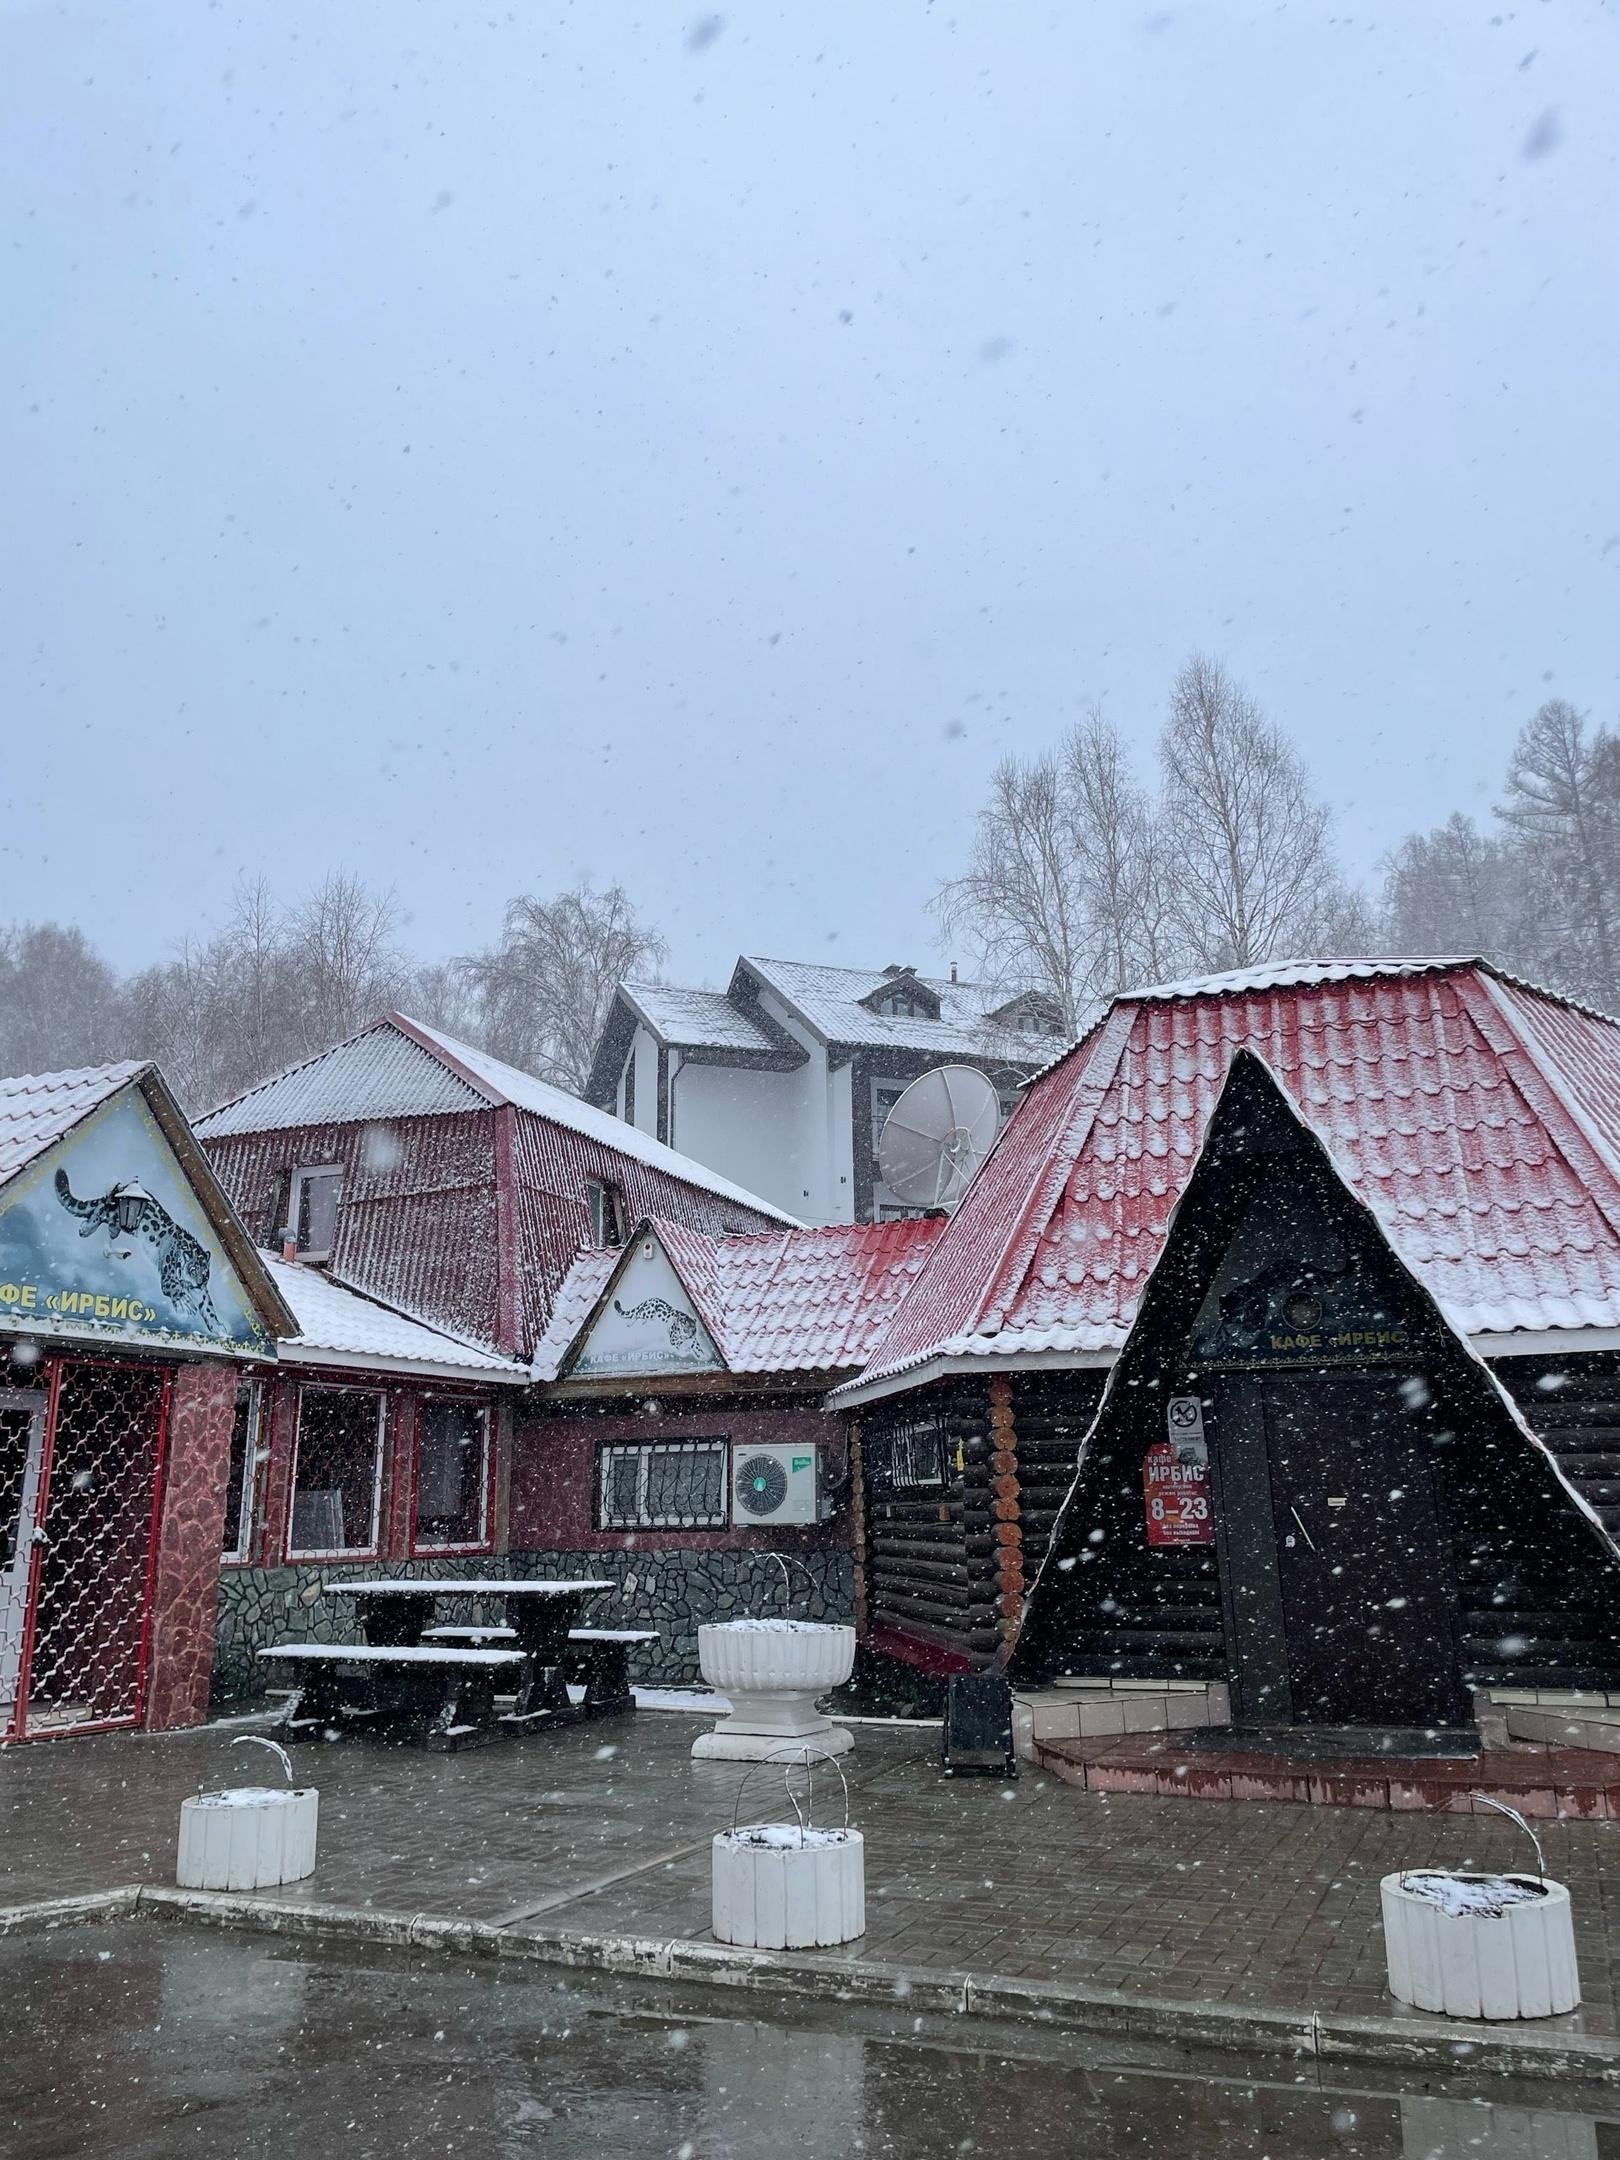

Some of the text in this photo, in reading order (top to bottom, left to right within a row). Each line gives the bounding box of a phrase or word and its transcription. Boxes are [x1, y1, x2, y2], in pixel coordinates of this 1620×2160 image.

[46, 1291, 157, 1322] «ИРБИС»
[1271, 1334, 1322, 1350] КАФЕ
[590, 1350, 669, 1364] КАФЕ «ИРБИС»
[1147, 1454, 1172, 1466] кафе
[1148, 1465, 1205, 1483] ИРБИС
